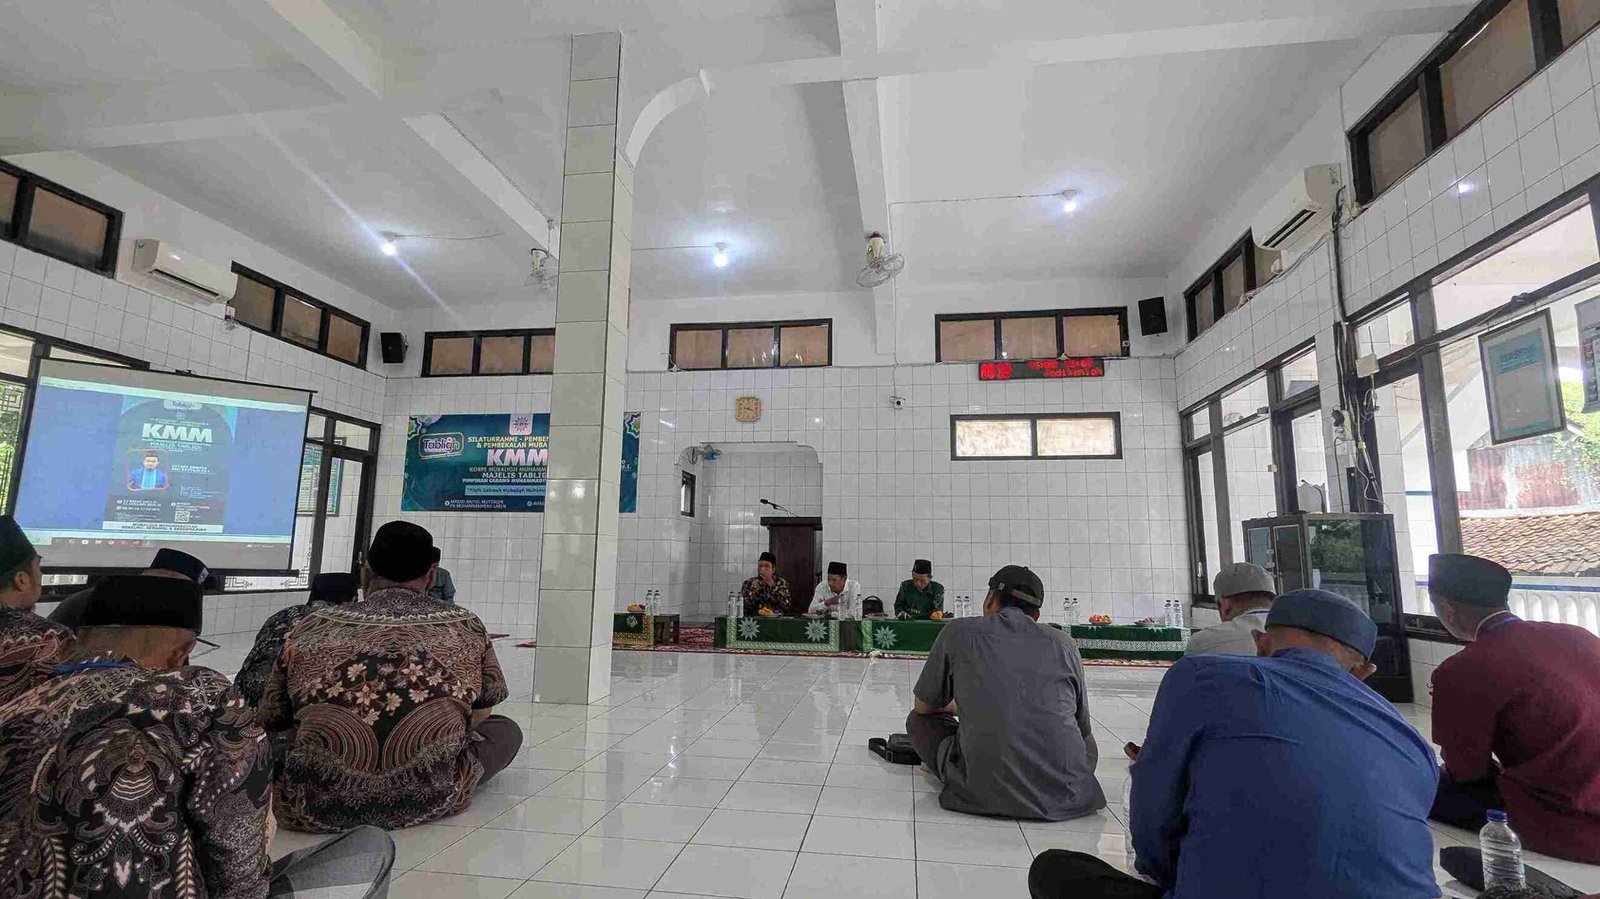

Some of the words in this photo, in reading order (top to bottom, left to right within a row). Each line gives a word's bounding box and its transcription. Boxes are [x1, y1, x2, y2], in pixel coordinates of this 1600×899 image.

[142, 423, 213, 443] KMM
[423, 436, 460, 452] Tabligh
[486, 448, 549, 466] KMM
